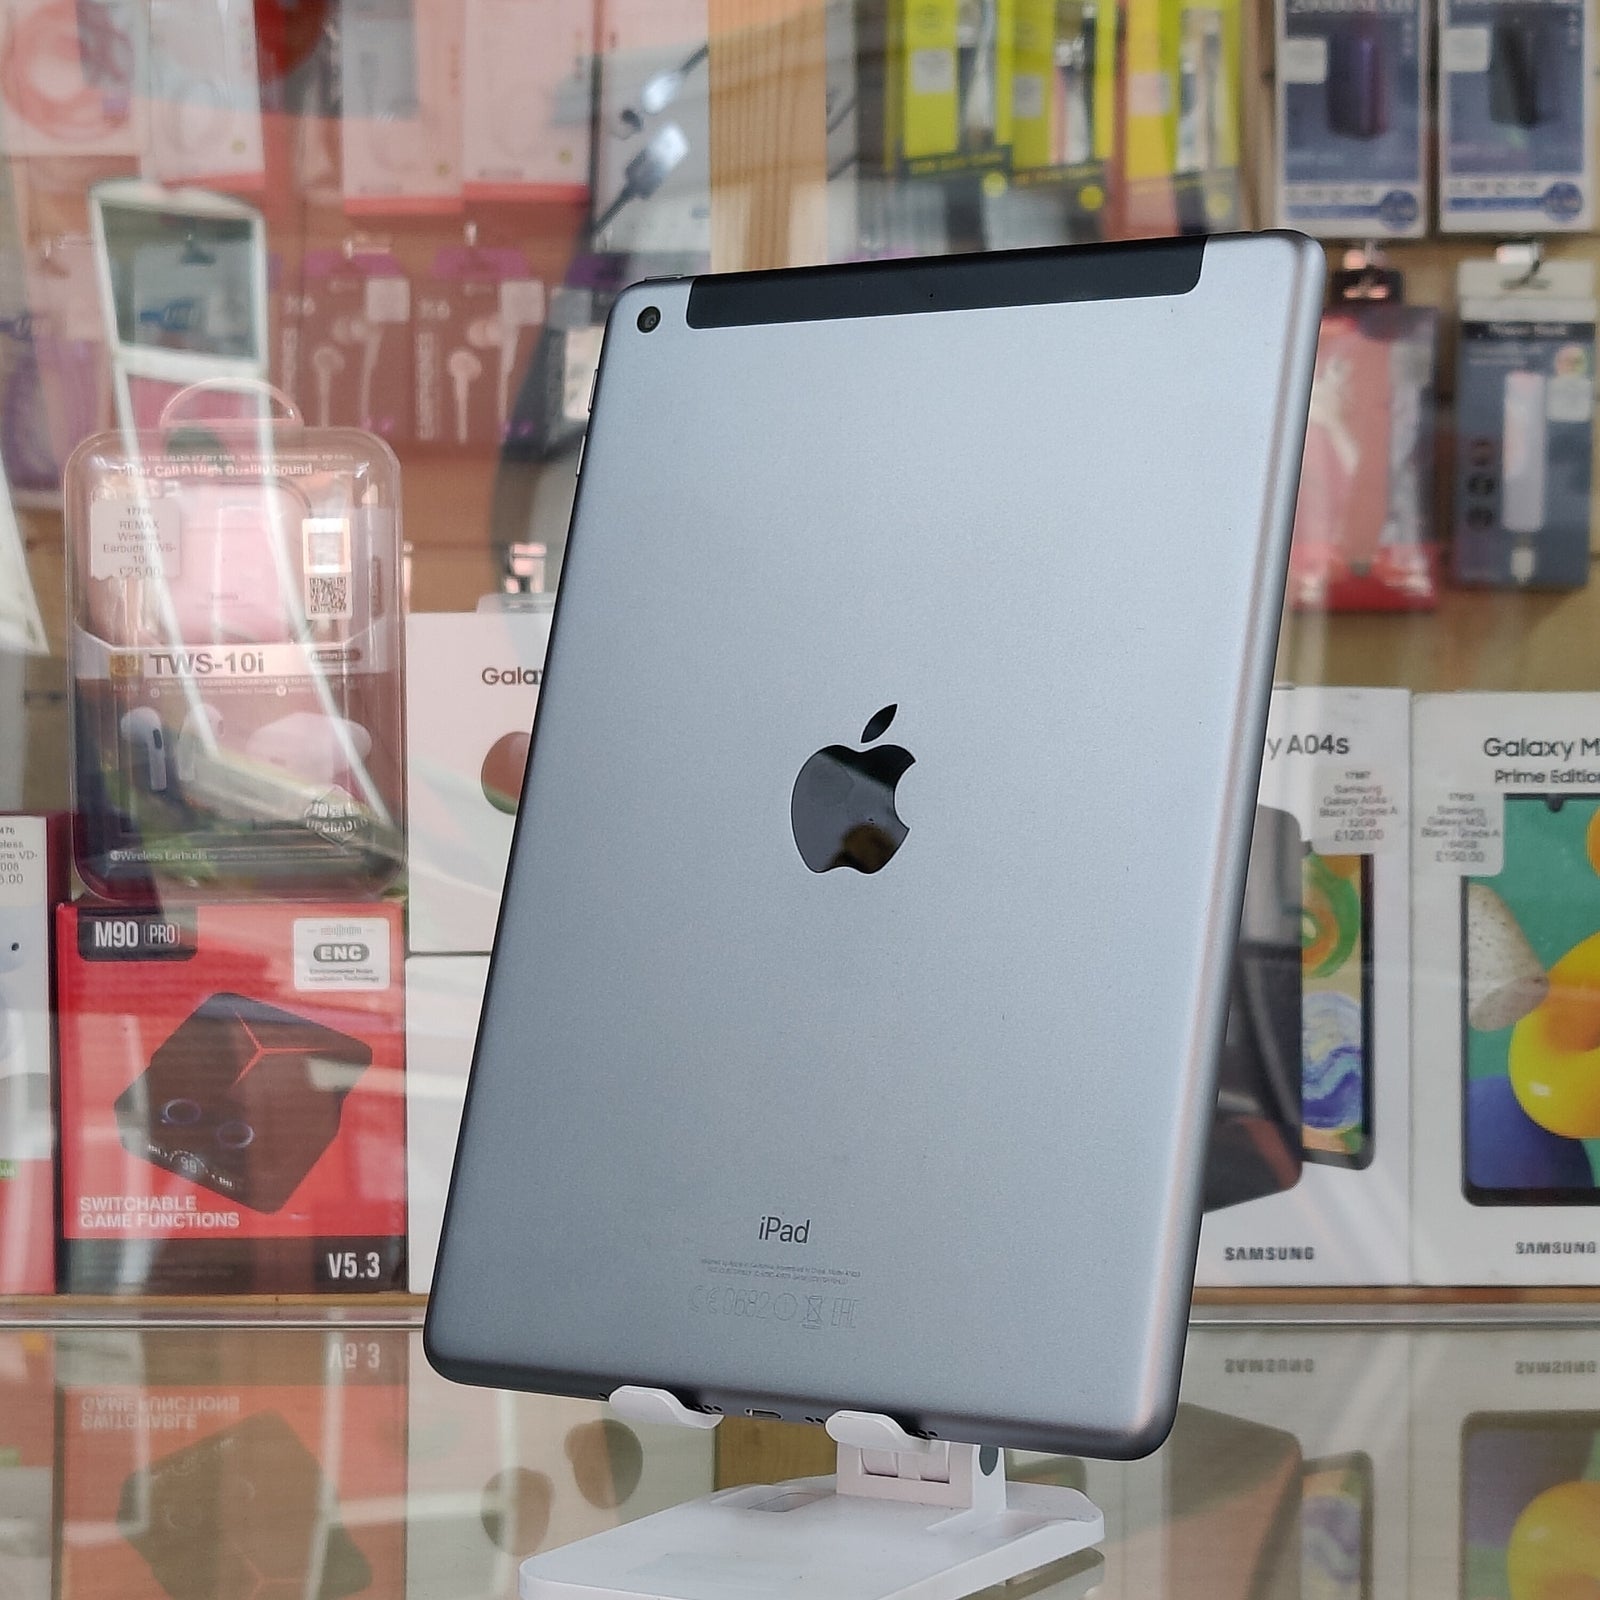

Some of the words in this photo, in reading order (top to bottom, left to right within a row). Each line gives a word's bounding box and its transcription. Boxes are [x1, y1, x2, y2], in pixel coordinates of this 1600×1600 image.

[272, 462, 313, 477] Sound
[149, 651, 265, 676] TWS-10i
[481, 666, 543, 685] Gala
[1286, 734, 1350, 756] A04s
[1483, 737, 1575, 761] Galaxy
[1494, 769, 1546, 784] Prime
[95, 921, 139, 948] M90
[319, 945, 362, 961] ENC
[79, 1196, 198, 1212] SWITCHABLE
[80, 1212, 133, 1229] GAME
[137, 1212, 240, 1229] FUNCTIONS
[758, 1216, 811, 1244] iPad
[1224, 1246, 1315, 1261] SAMSUNG
[1515, 1240, 1597, 1255] SAMSUNG
[328, 1251, 381, 1279] V5.3
